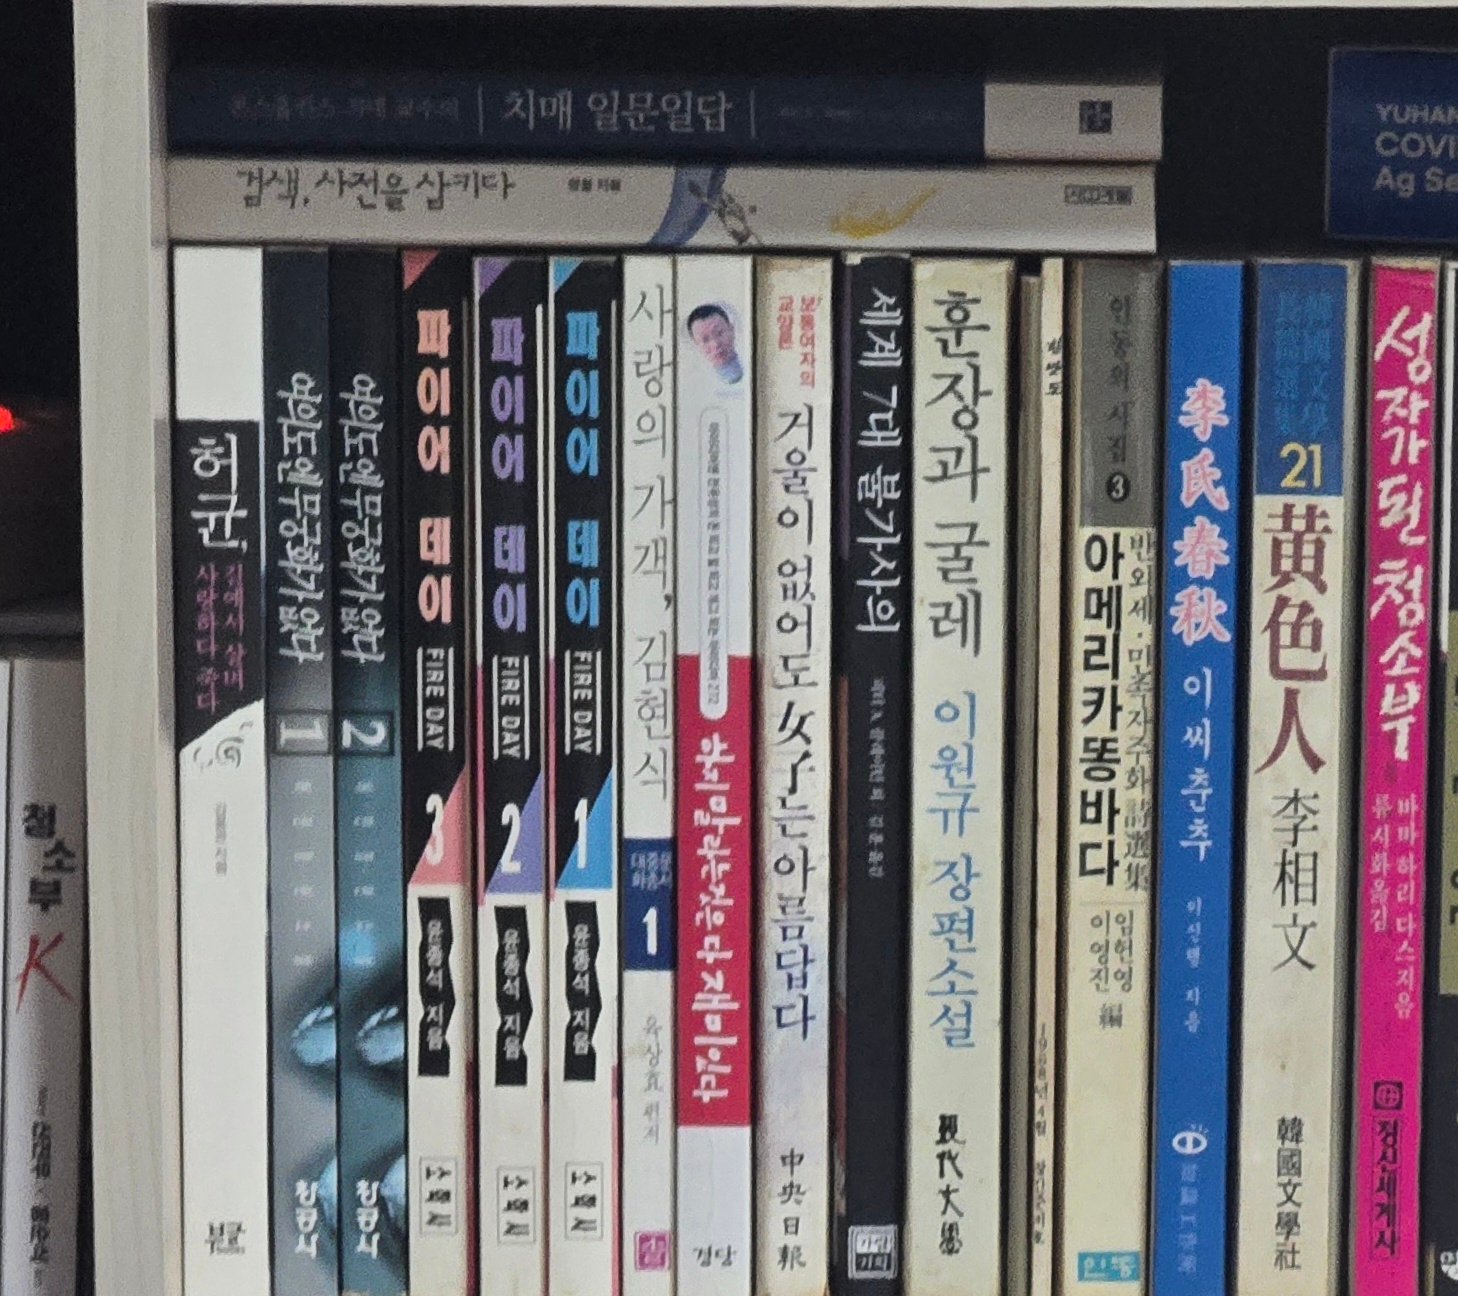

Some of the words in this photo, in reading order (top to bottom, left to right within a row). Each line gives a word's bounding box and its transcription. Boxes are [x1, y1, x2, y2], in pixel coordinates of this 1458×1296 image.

[502, 87, 574, 133] 치매
[587, 87, 735, 135] 일문일답
[235, 168, 308, 208] 검색,
[316, 168, 407, 212] 사전을
[413, 168, 516, 210] 삼키다
[1373, 165, 1416, 199] Ag
[630, 284, 672, 459] 사랑의
[858, 287, 903, 368] 세계
[276, 372, 322, 485] 여의도엔
[338, 374, 384, 485] 여의도엔
[416, 310, 452, 474] 파이어
[491, 317, 525, 482] 파이어
[566, 311, 600, 477] 파이어
[858, 385, 903, 447] 7대
[924, 290, 993, 503] 훈장과
[1374, 305, 1433, 465] 성자가
[773, 402, 818, 546] 거울이
[1169, 377, 1233, 645] 李氏春秋
[1279, 442, 1324, 488] 21
[277, 487, 325, 602] 무궁화가
[338, 488, 385, 602] 무궁화가
[419, 516, 453, 624] 데이
[494, 525, 527, 633] 데이
[566, 520, 600, 629] 데이
[631, 474, 672, 612] 가객,
[856, 463, 902, 632] 불가사의
[923, 521, 991, 656] 굴레
[279, 605, 325, 664] 없다
[340, 606, 386, 665] 없다
[427, 648, 446, 698] FIRE
[573, 651, 593, 701] FIRE
[771, 554, 818, 689] 없어도
[1082, 532, 1126, 732] 아메리카
[1255, 503, 1334, 777] 黃色人
[1371, 558, 1426, 762] 청소부
[280, 718, 328, 748] 1
[342, 720, 386, 748] 2
[427, 706, 446, 750] DAY
[501, 656, 520, 706] FIRE
[501, 714, 520, 758] DAY
[573, 709, 594, 753] DAY
[631, 630, 672, 801] 김현식
[694, 732, 735, 790] 하지
[926, 690, 980, 838] 이원규
[1079, 735, 1123, 888] 똥바다
[1177, 665, 1213, 863] 이씨춘추
[425, 794, 444, 866] 3
[501, 803, 521, 874] 2
[574, 799, 587, 868] 1
[1271, 788, 1320, 972] 李相文
[643, 907, 658, 956] 1
[771, 842, 818, 1040] 아름답다
[924, 852, 982, 1050] 장편소설
[691, 970, 740, 1103] 재미있다
[778, 1148, 807, 1270] 中央日報
[1273, 1116, 1305, 1272] 韓國文學社
